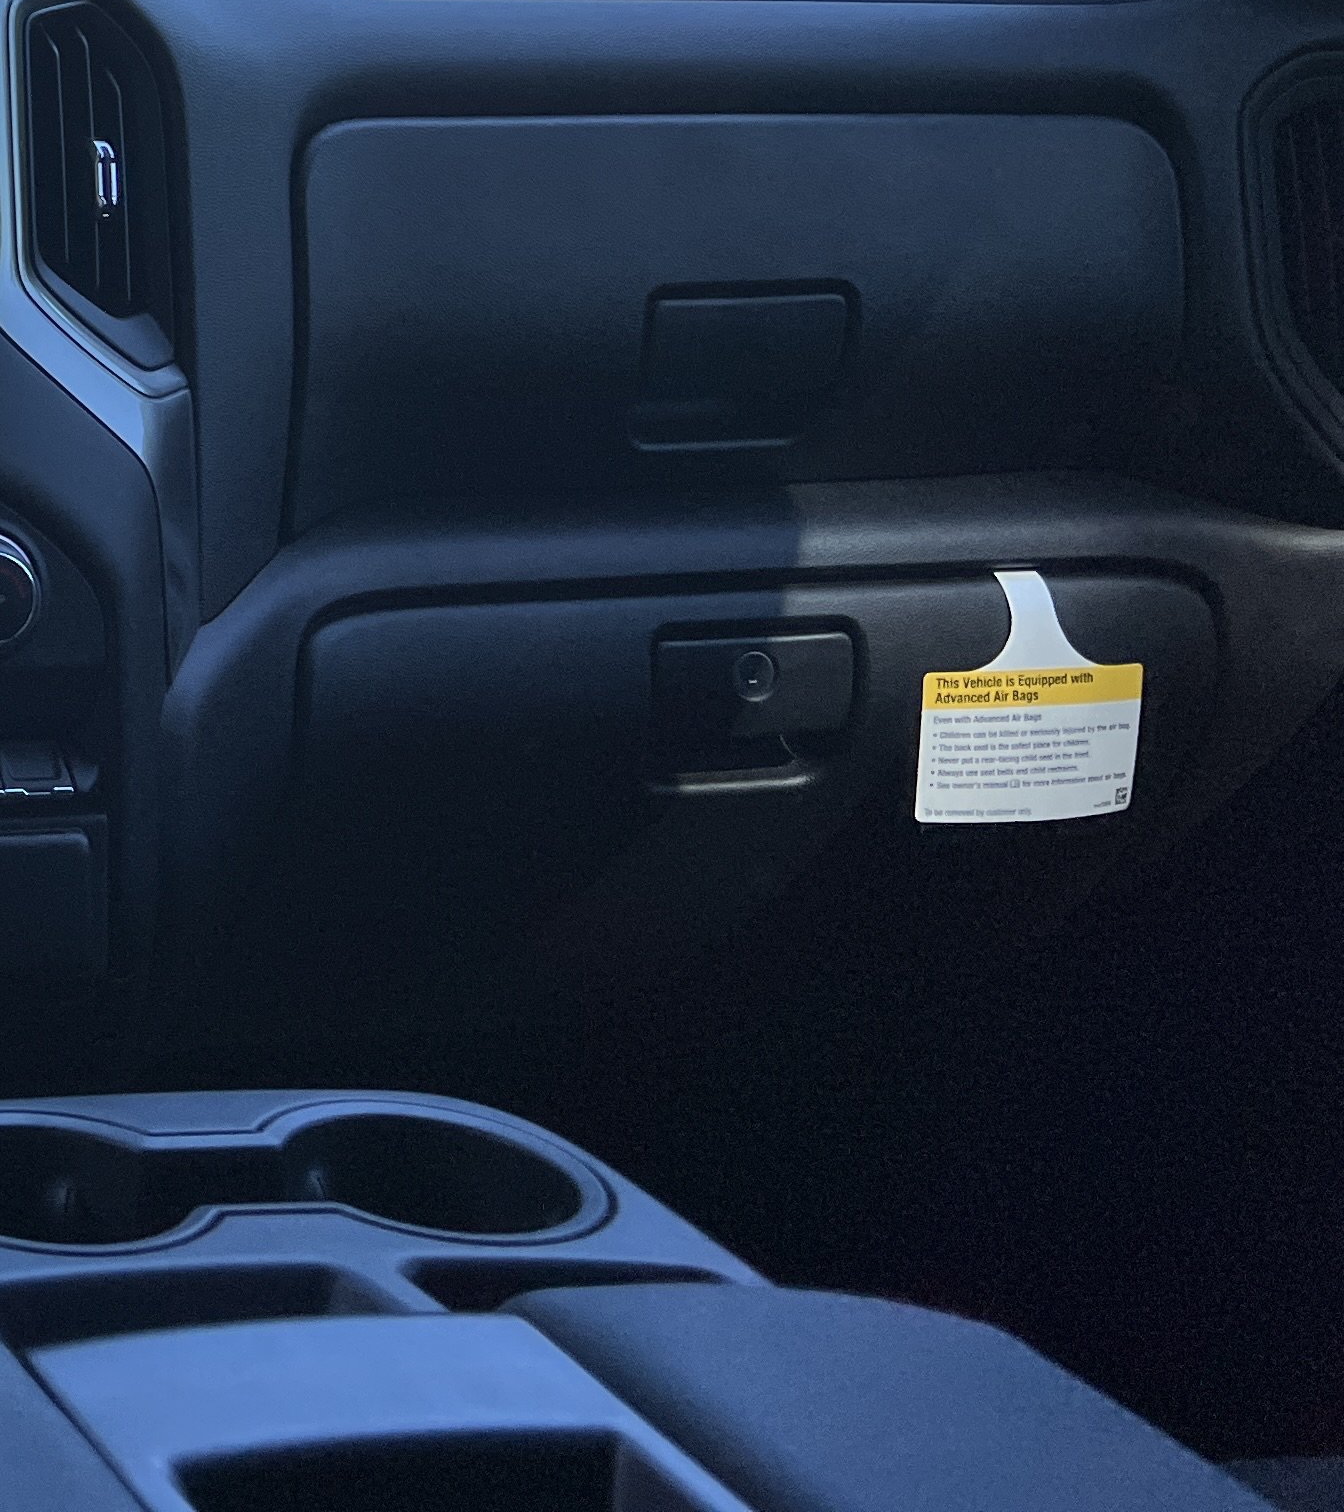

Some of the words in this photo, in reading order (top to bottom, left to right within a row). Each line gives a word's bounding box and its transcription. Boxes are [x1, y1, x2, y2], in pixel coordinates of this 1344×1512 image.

[936, 678, 959, 689] This
[963, 676, 1002, 689] Vehicle
[1005, 676, 1015, 687] is
[1018, 673, 1068, 689] Equipped
[1070, 673, 1094, 684] with
[935, 691, 990, 704] Advanced
[993, 691, 1009, 702] Air
[1012, 690, 1039, 704] Bags
